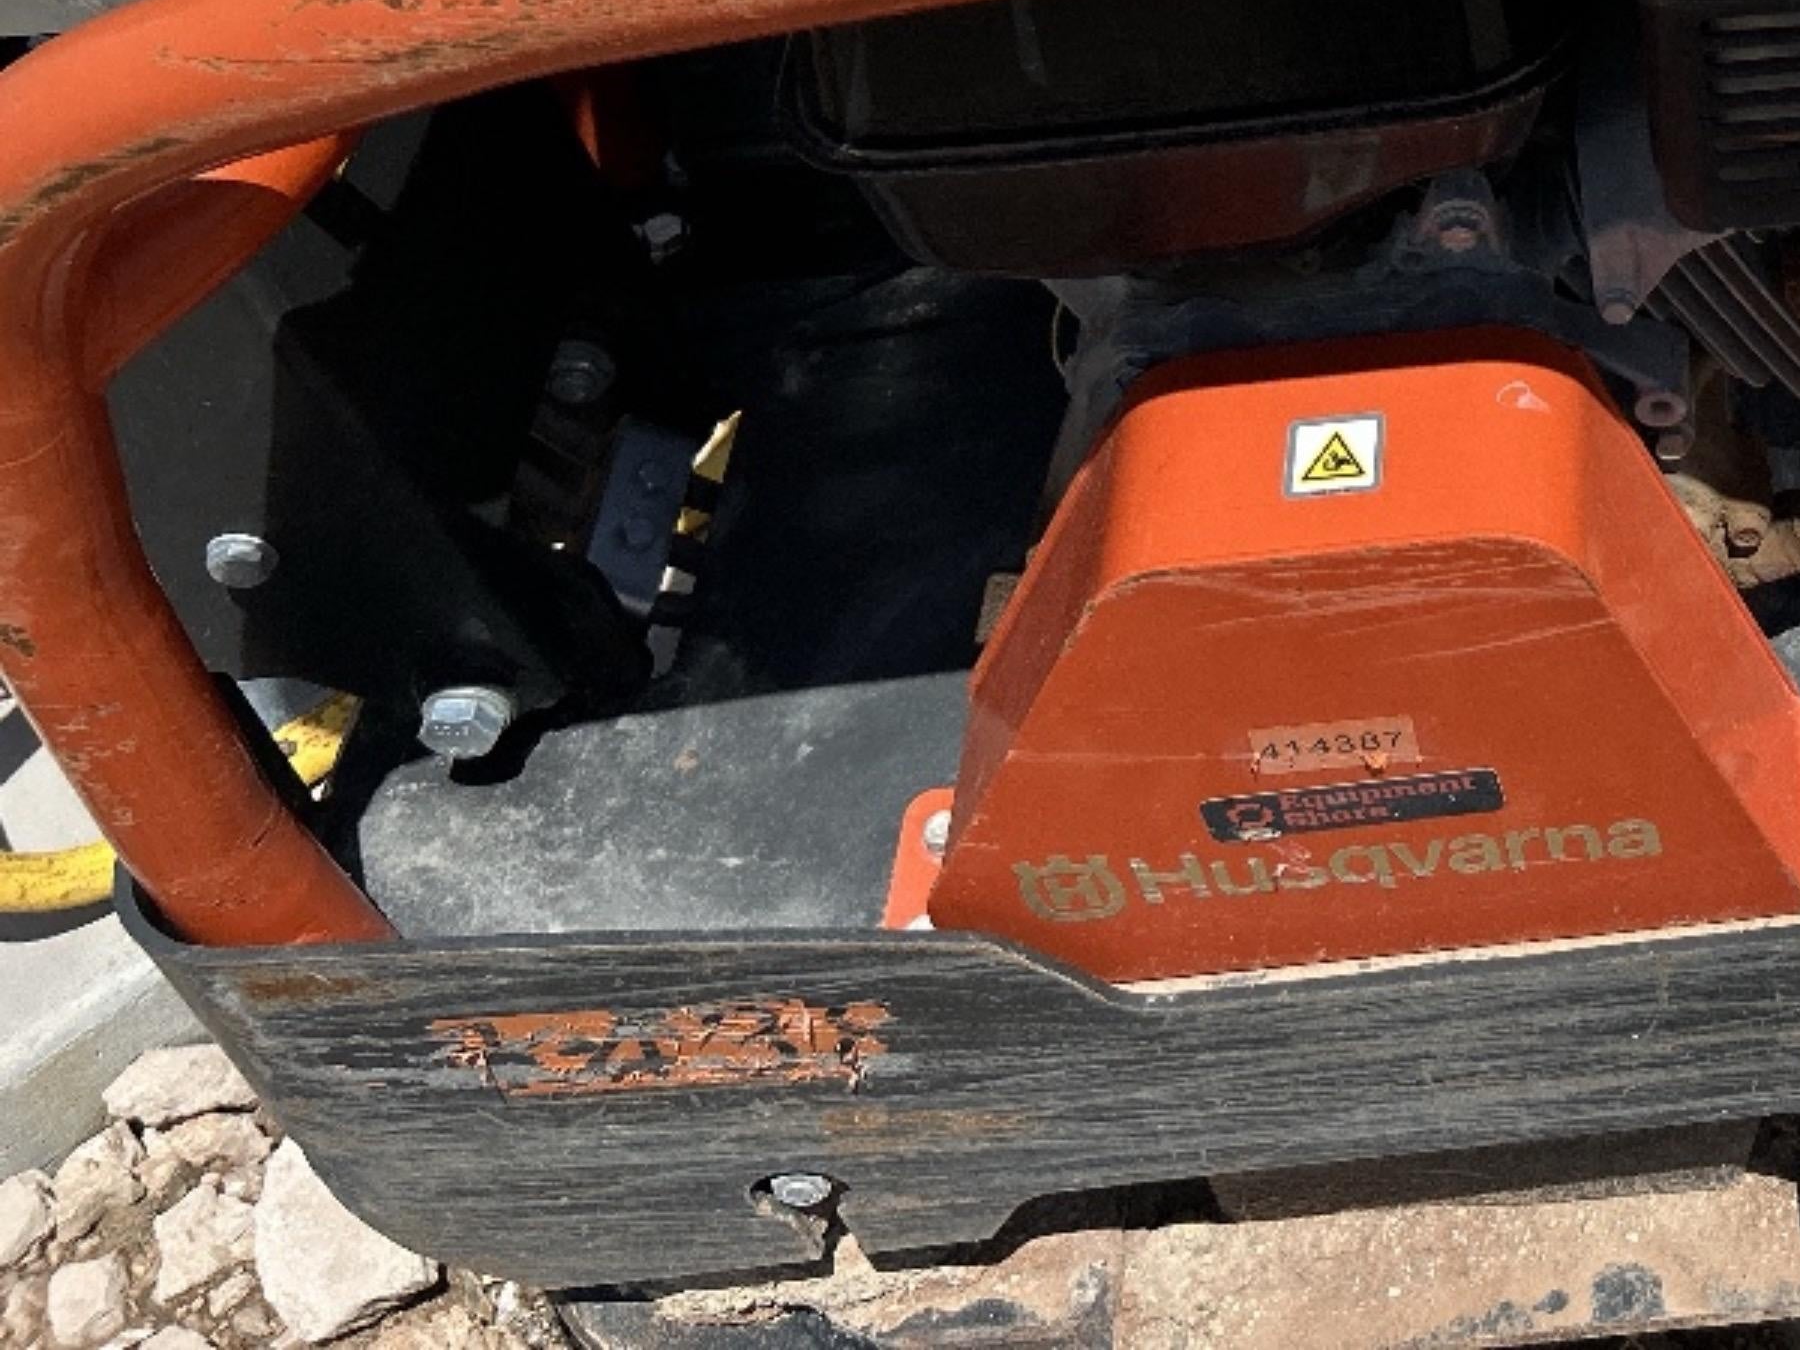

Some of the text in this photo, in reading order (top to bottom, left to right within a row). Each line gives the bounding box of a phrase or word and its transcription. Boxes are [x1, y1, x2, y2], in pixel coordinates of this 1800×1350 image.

[1259, 731, 1403, 760] 414387
[1279, 776, 1477, 812] Equipment
[1129, 817, 1663, 903] Husqvarna
